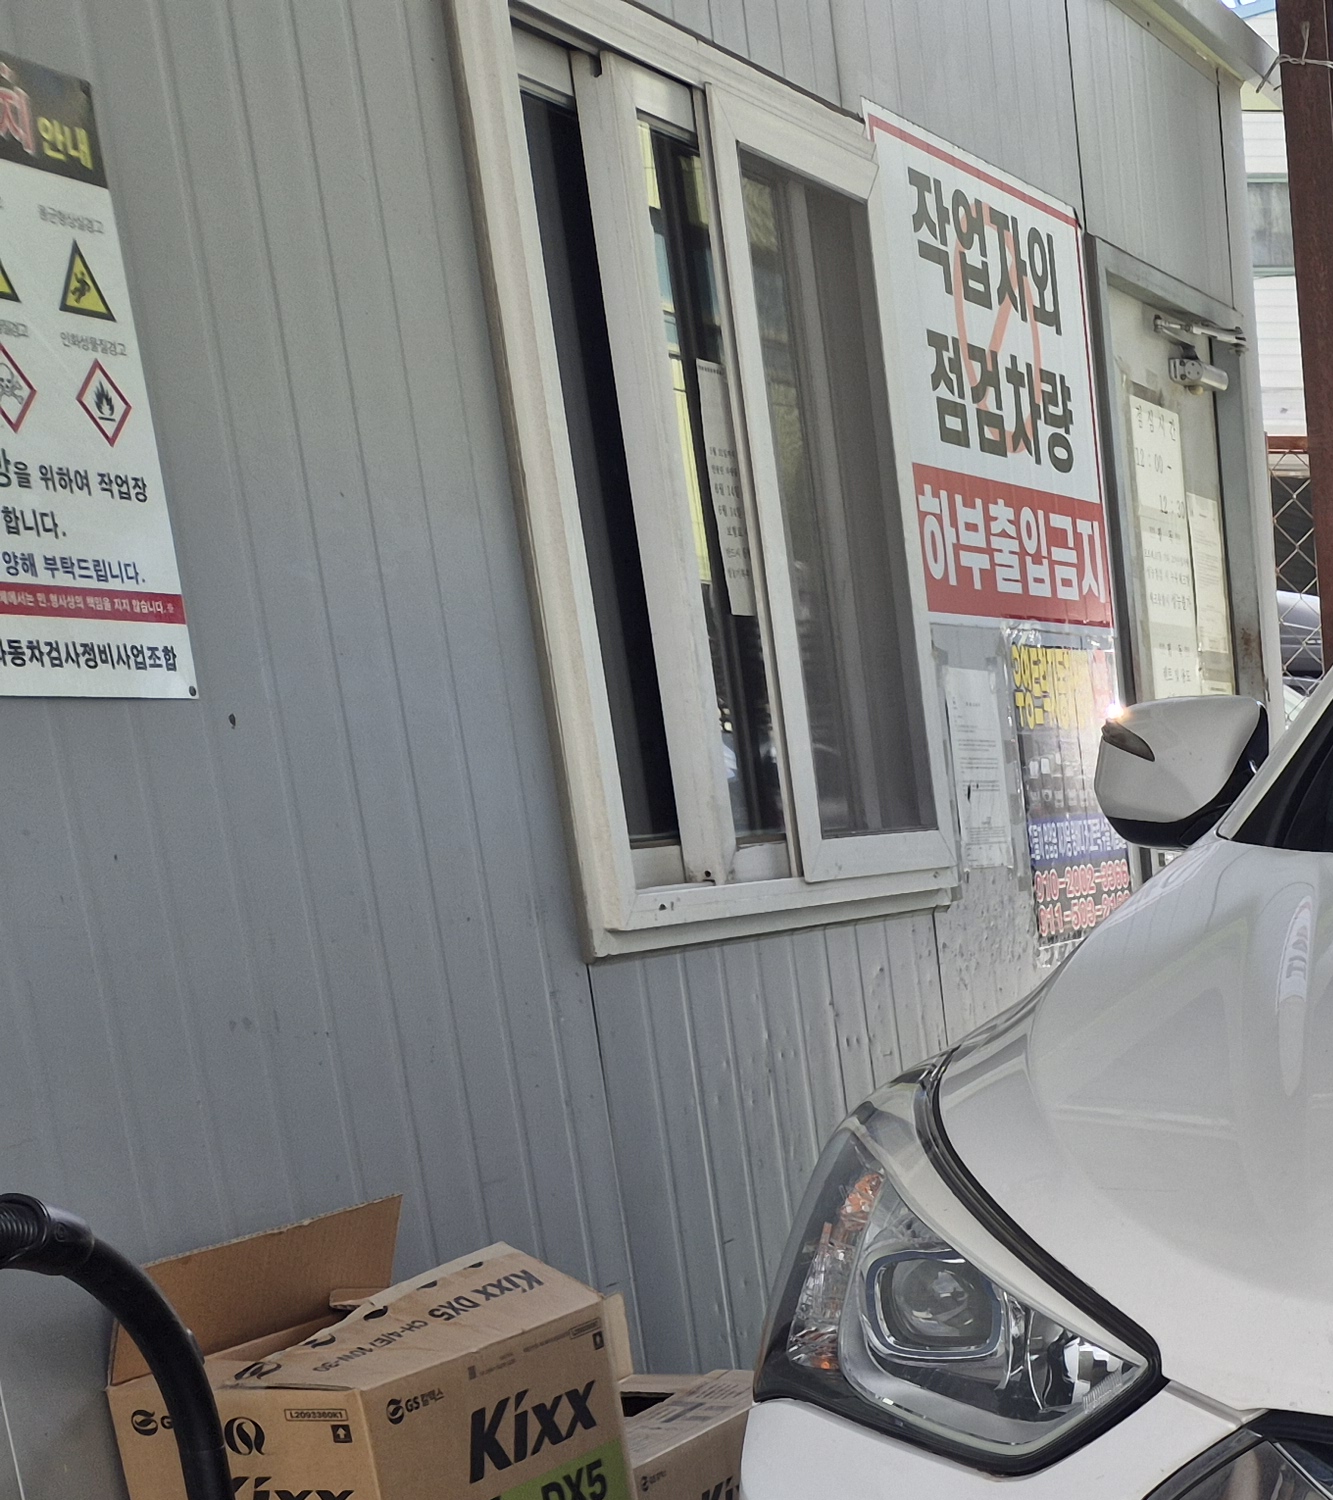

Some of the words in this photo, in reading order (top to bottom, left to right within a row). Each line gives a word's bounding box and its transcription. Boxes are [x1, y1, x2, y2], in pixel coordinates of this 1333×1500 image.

[37, 116, 94, 170] 안내
[907, 166, 1063, 336] 작업자외
[926, 328, 1075, 474] 점검차량
[39, 464, 92, 497] 위하여
[97, 471, 149, 503] 작업장
[1, 505, 67, 540] 합니다.
[917, 483, 1106, 604] 하부출입금지
[2, 550, 39, 579] 양해
[43, 554, 146, 586] 부탁드립니다.
[429, 1295, 481, 1322] DX5
[472, 1269, 544, 1302] Kixx
[469, 1379, 598, 1484] Kixx
